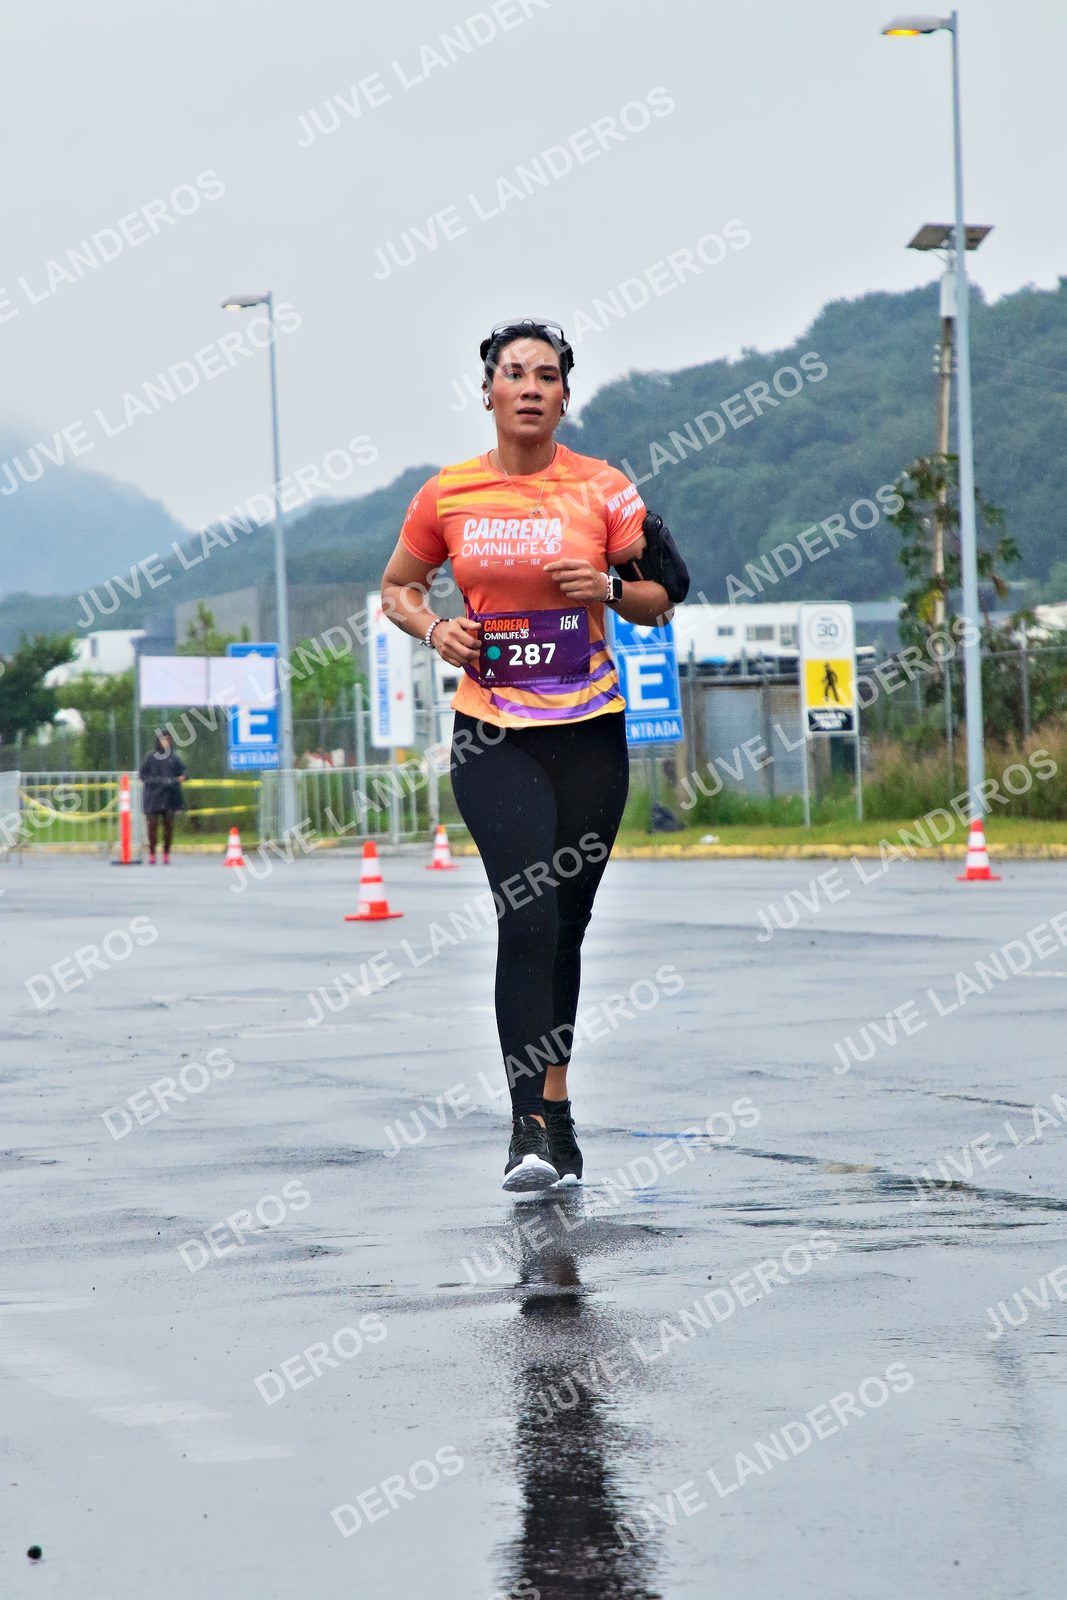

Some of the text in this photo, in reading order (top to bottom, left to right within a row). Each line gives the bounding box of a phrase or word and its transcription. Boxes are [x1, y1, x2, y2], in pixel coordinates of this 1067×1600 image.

[463, 517, 562, 540] CARRERA
[461, 541, 539, 557] OMNILIFE
[484, 618, 529, 631] CARRERA
[559, 615, 580, 630] 15K
[817, 624, 839, 637] 30
[484, 631, 519, 640] OMNILIFE
[508, 642, 556, 666] 287
[625, 653, 670, 711] E
[238, 704, 273, 743] E
